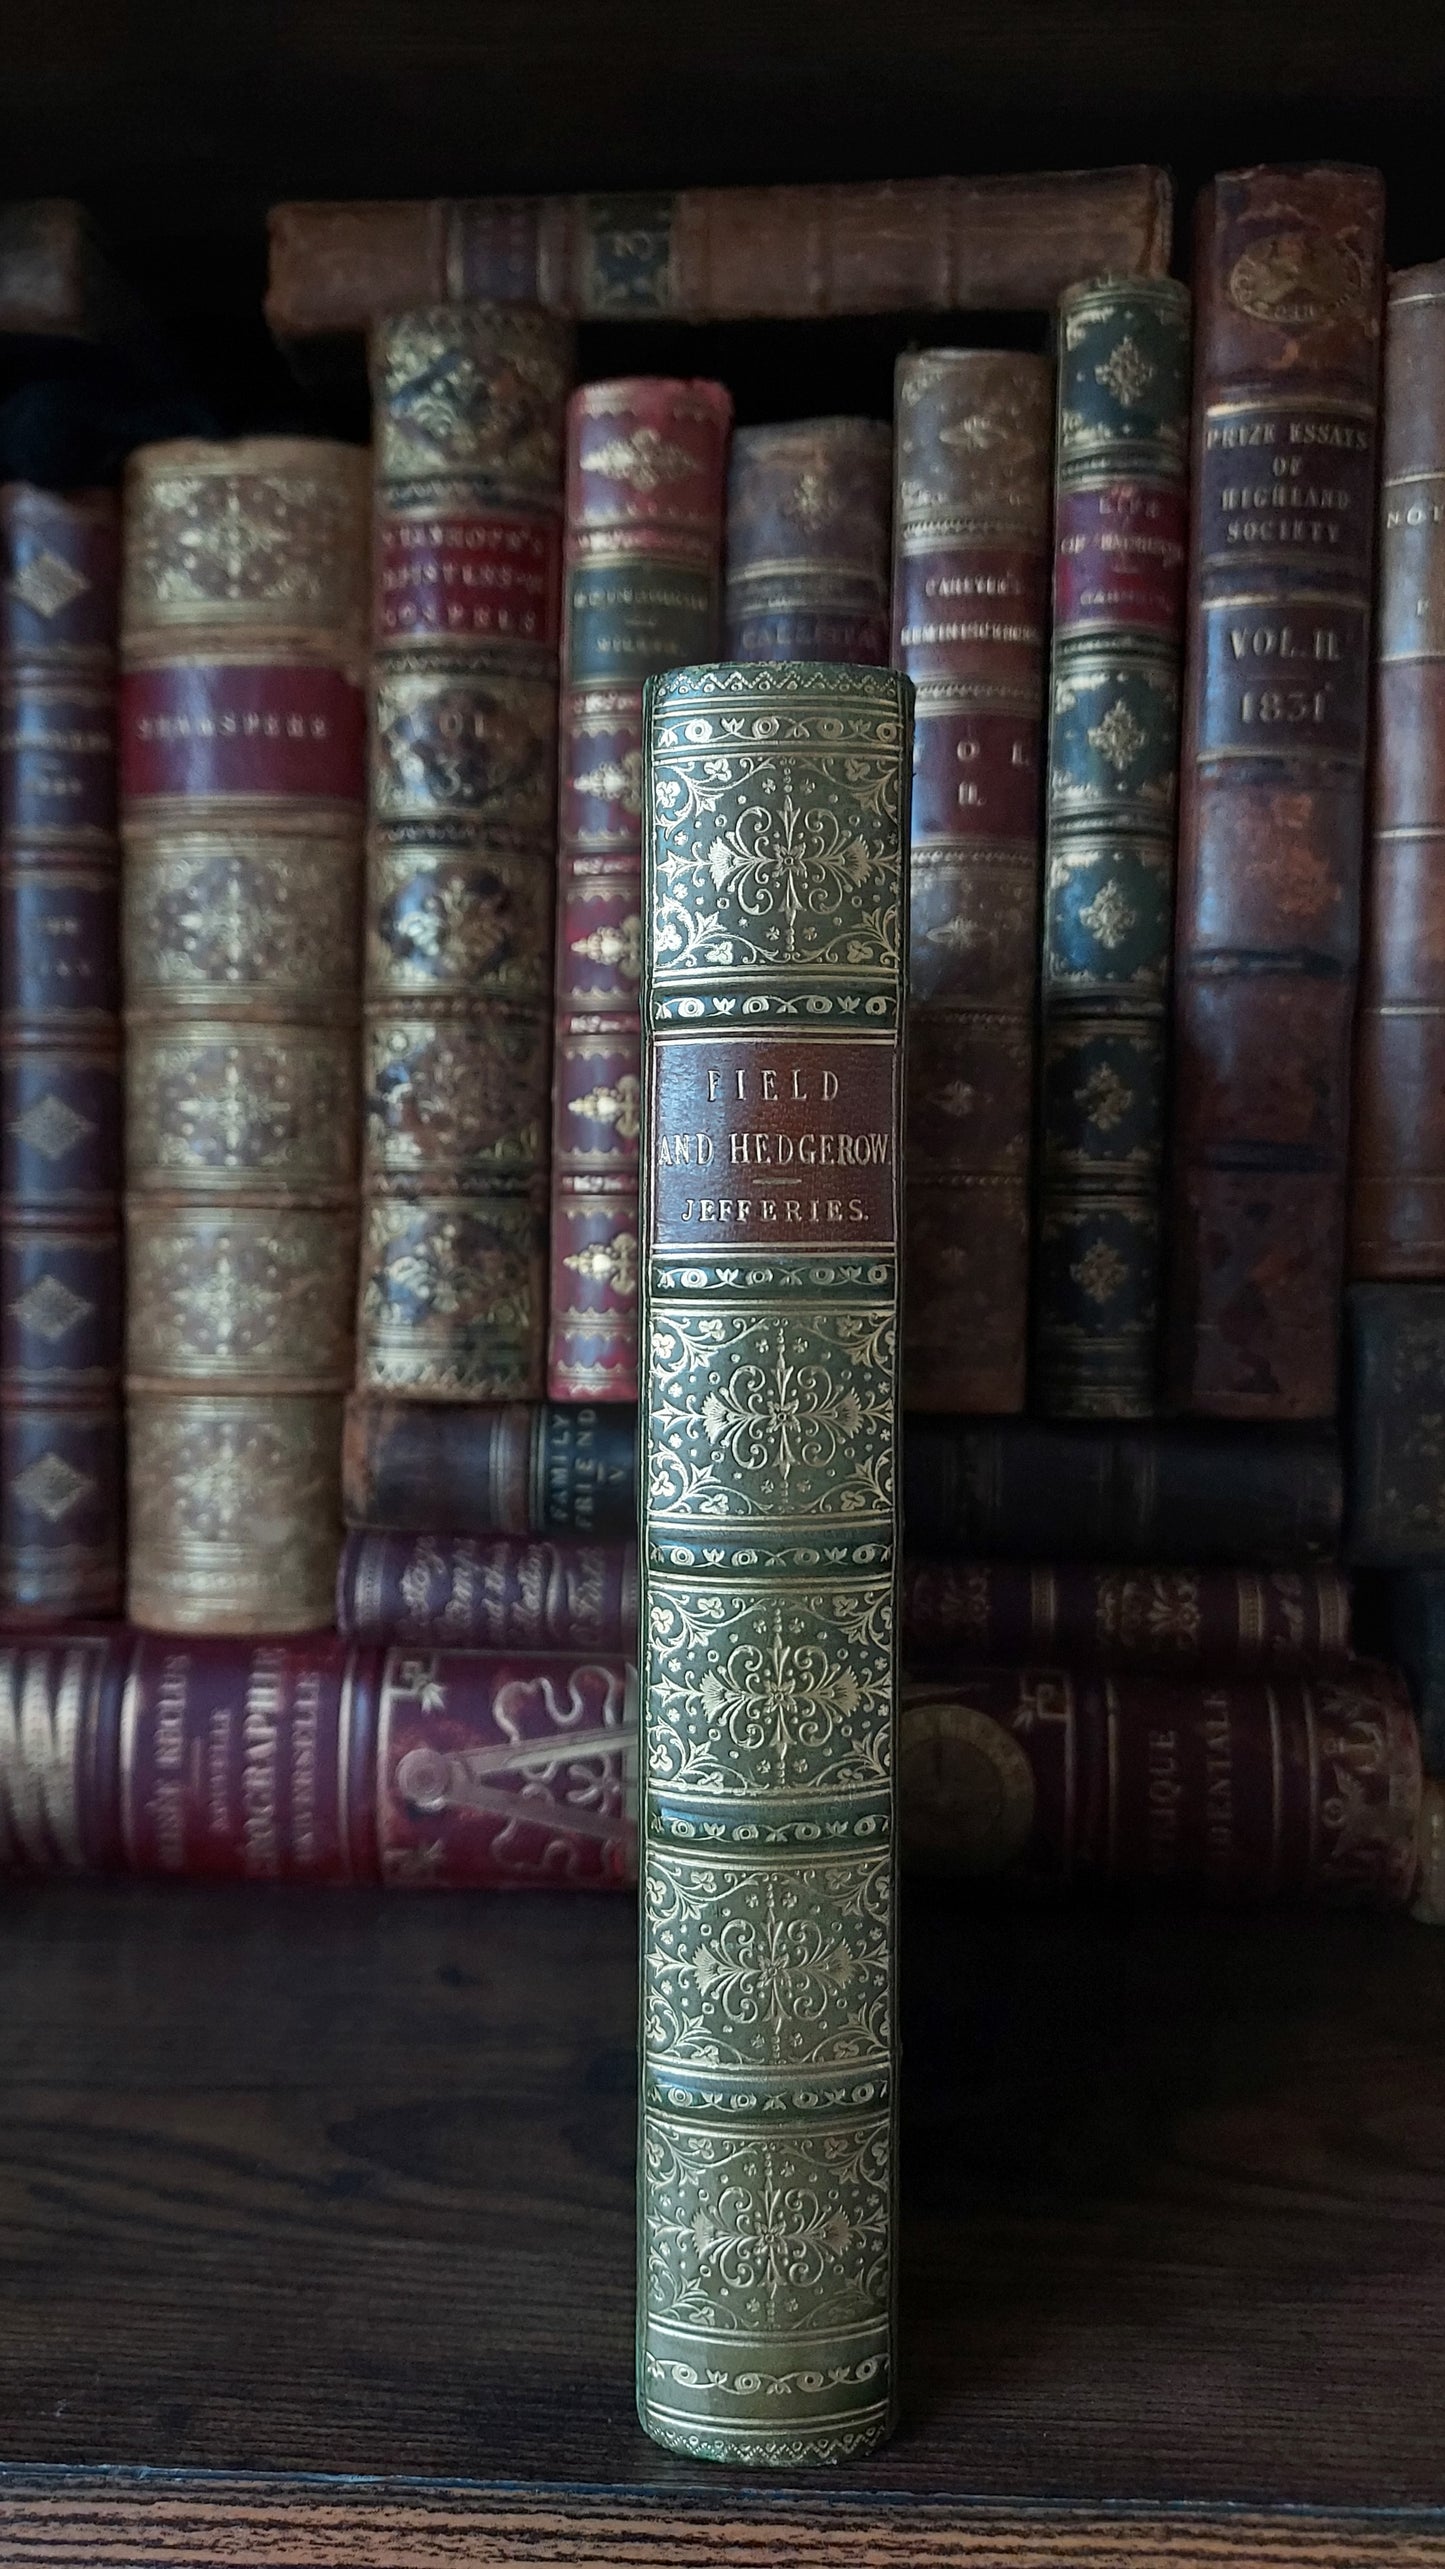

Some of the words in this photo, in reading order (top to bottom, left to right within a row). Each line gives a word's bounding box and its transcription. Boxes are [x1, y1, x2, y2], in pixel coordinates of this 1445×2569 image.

[1207, 423, 1275, 449] PRIZE
[1290, 423, 1368, 449] ESSAYS
[1272, 455, 1303, 477] OF
[1221, 485, 1351, 511] HIGHLAND
[1227, 518, 1341, 544] SOCIETY
[1242, 691, 1326, 724] 1831
[707, 1069, 839, 1102] FIELD
[658, 1132, 714, 1166] AND
[681, 1199, 870, 1223] JEFFERIES.
[550, 1413, 571, 1522] FAMILY
[574, 1407, 597, 1530] FRIEND
